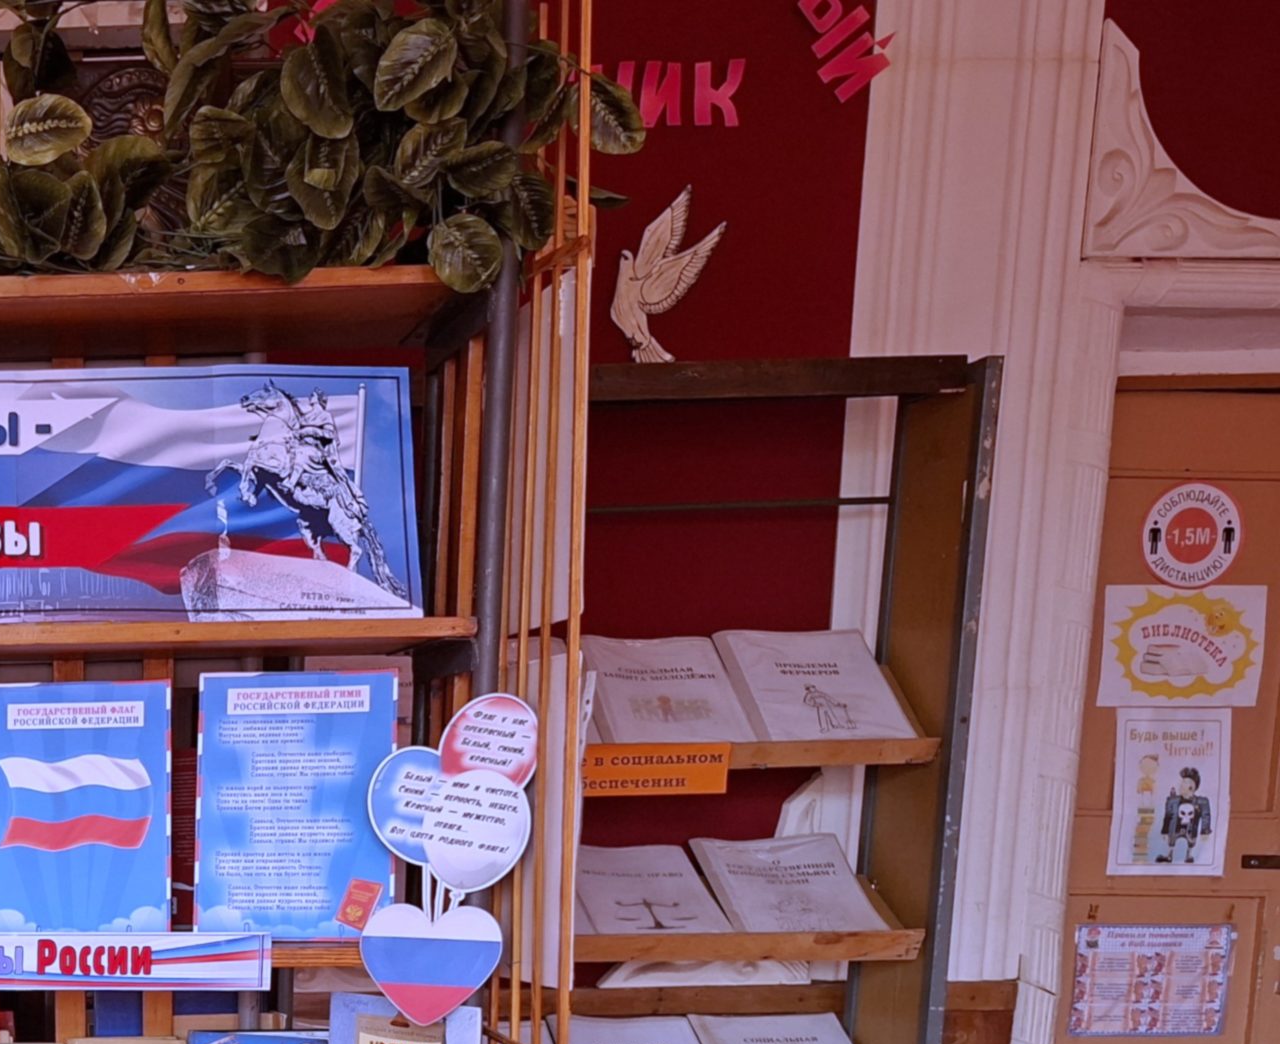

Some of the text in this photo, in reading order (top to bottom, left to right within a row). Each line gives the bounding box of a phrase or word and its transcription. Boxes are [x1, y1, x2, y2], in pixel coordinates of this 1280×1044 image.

[1157, 490, 1230, 518] СОБЛЮДАЙТЕ
[1151, 555, 1227, 583] ДИСТАНЦИЮ!
[1141, 624, 1228, 668] БИБЛИОТЕКА
[333, 689, 362, 699] ГИМН
[110, 705, 136, 715] ФЛАГ
[233, 699, 365, 711] РОССИЙСКОЙ ФЕДЕРАЦИИ
[13, 715, 140, 726] РОССИЙСКОЙ ФЕДЕРАЦИИ
[1129, 728, 1159, 742] Будь
[610, 752, 724, 767] социальном
[581, 776, 687, 791] беспечении
[36, 939, 153, 976] России
